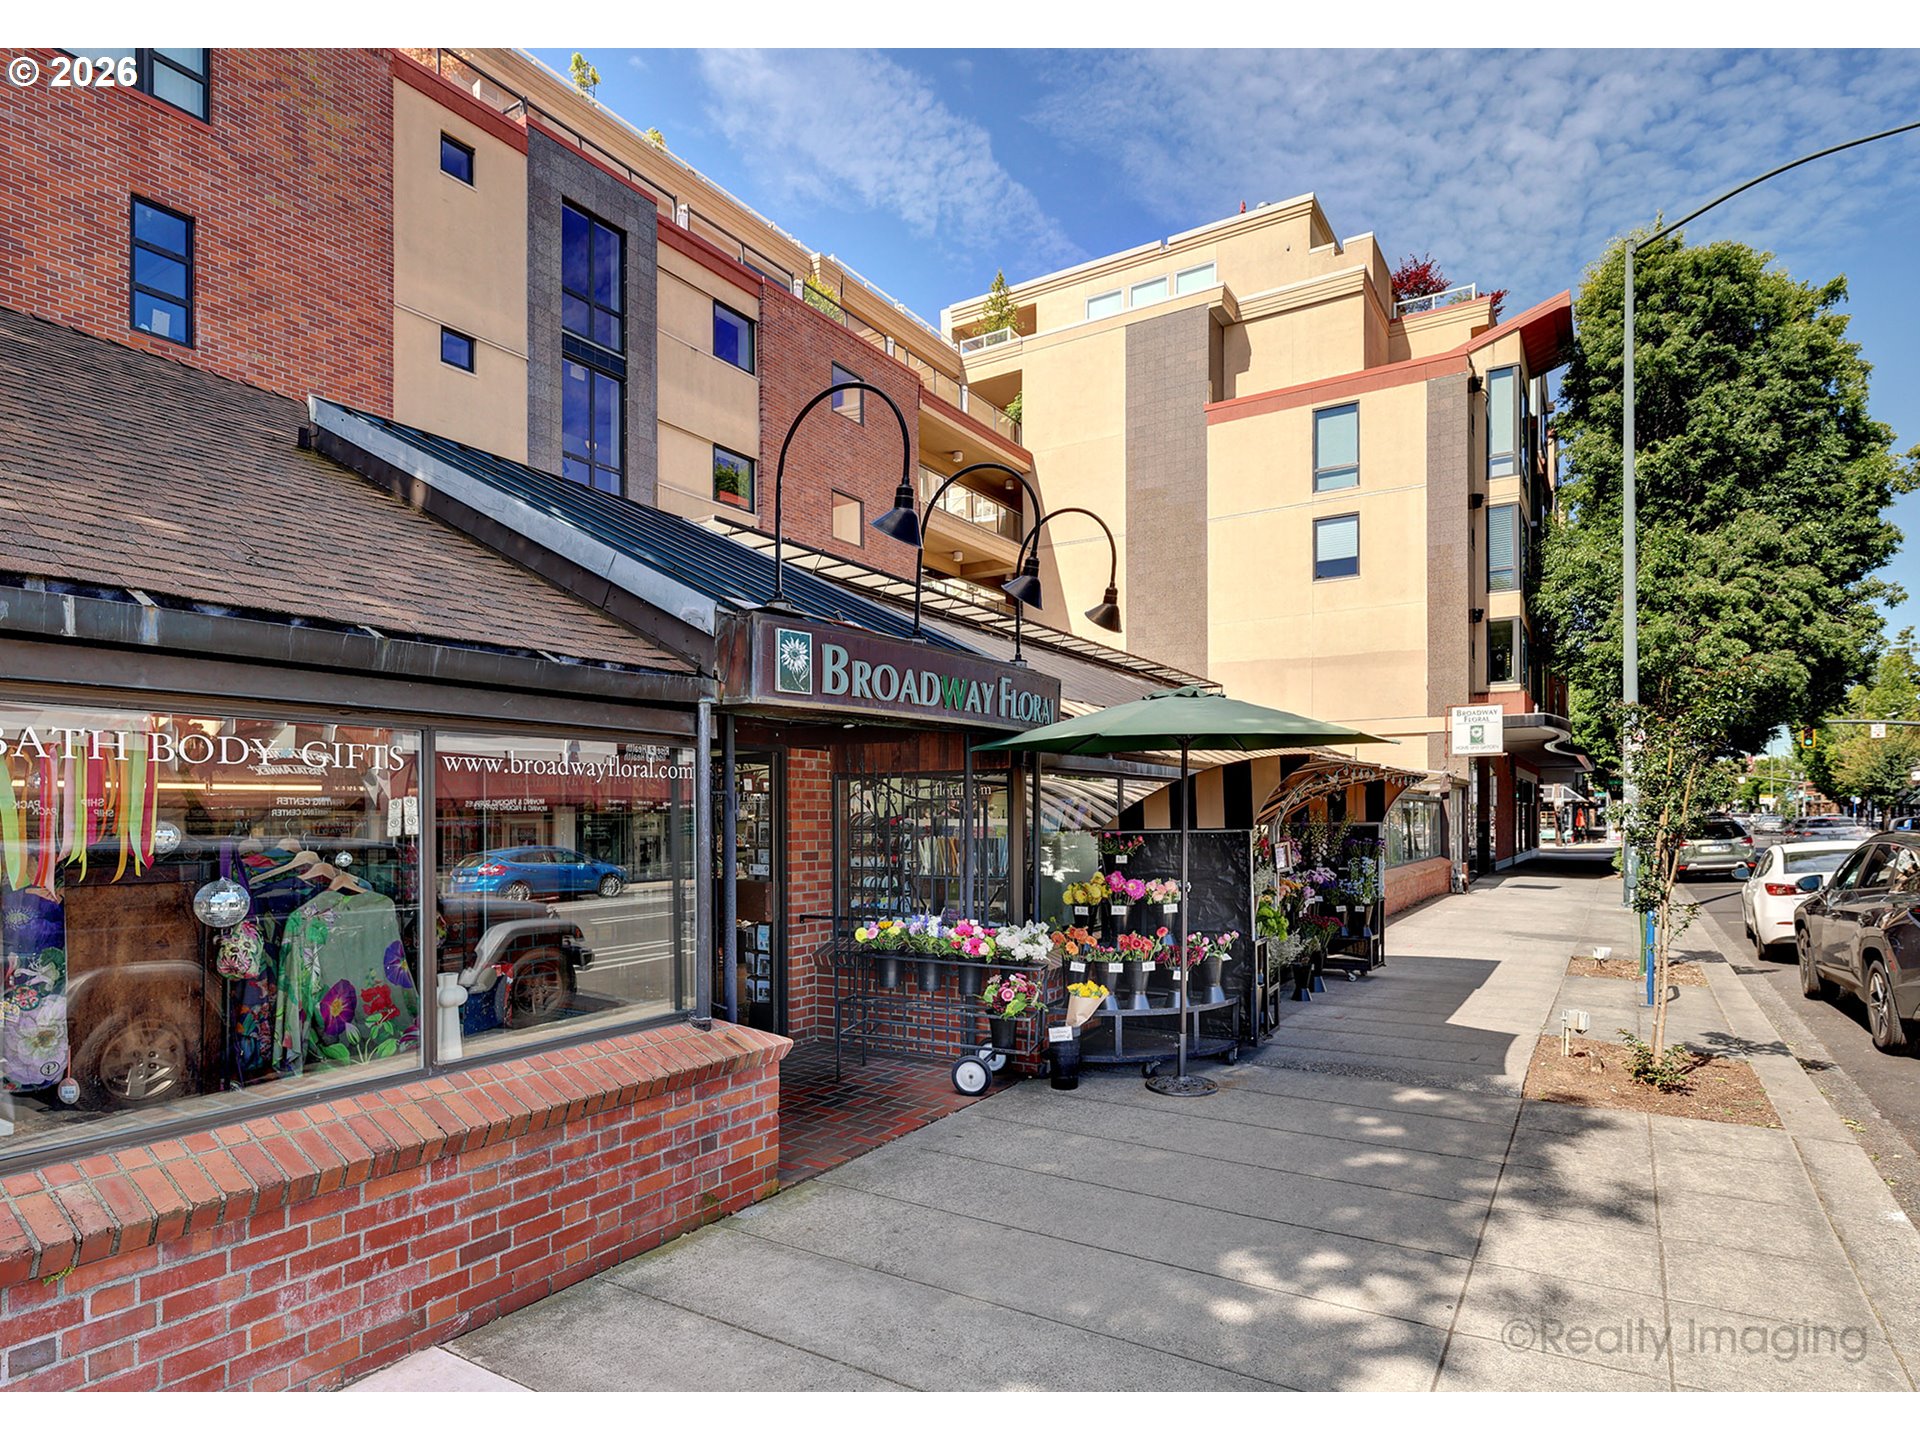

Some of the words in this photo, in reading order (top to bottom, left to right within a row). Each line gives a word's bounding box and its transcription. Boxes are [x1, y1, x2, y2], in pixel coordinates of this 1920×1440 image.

[821, 643, 995, 712] BROADWAY
[1456, 709, 1498, 717] BROADWAY
[0, 726, 129, 761] ATH
[148, 732, 279, 766] BODY
[301, 741, 405, 771] GIFTS
[442, 750, 694, 783] www.broadwayfloral.com
